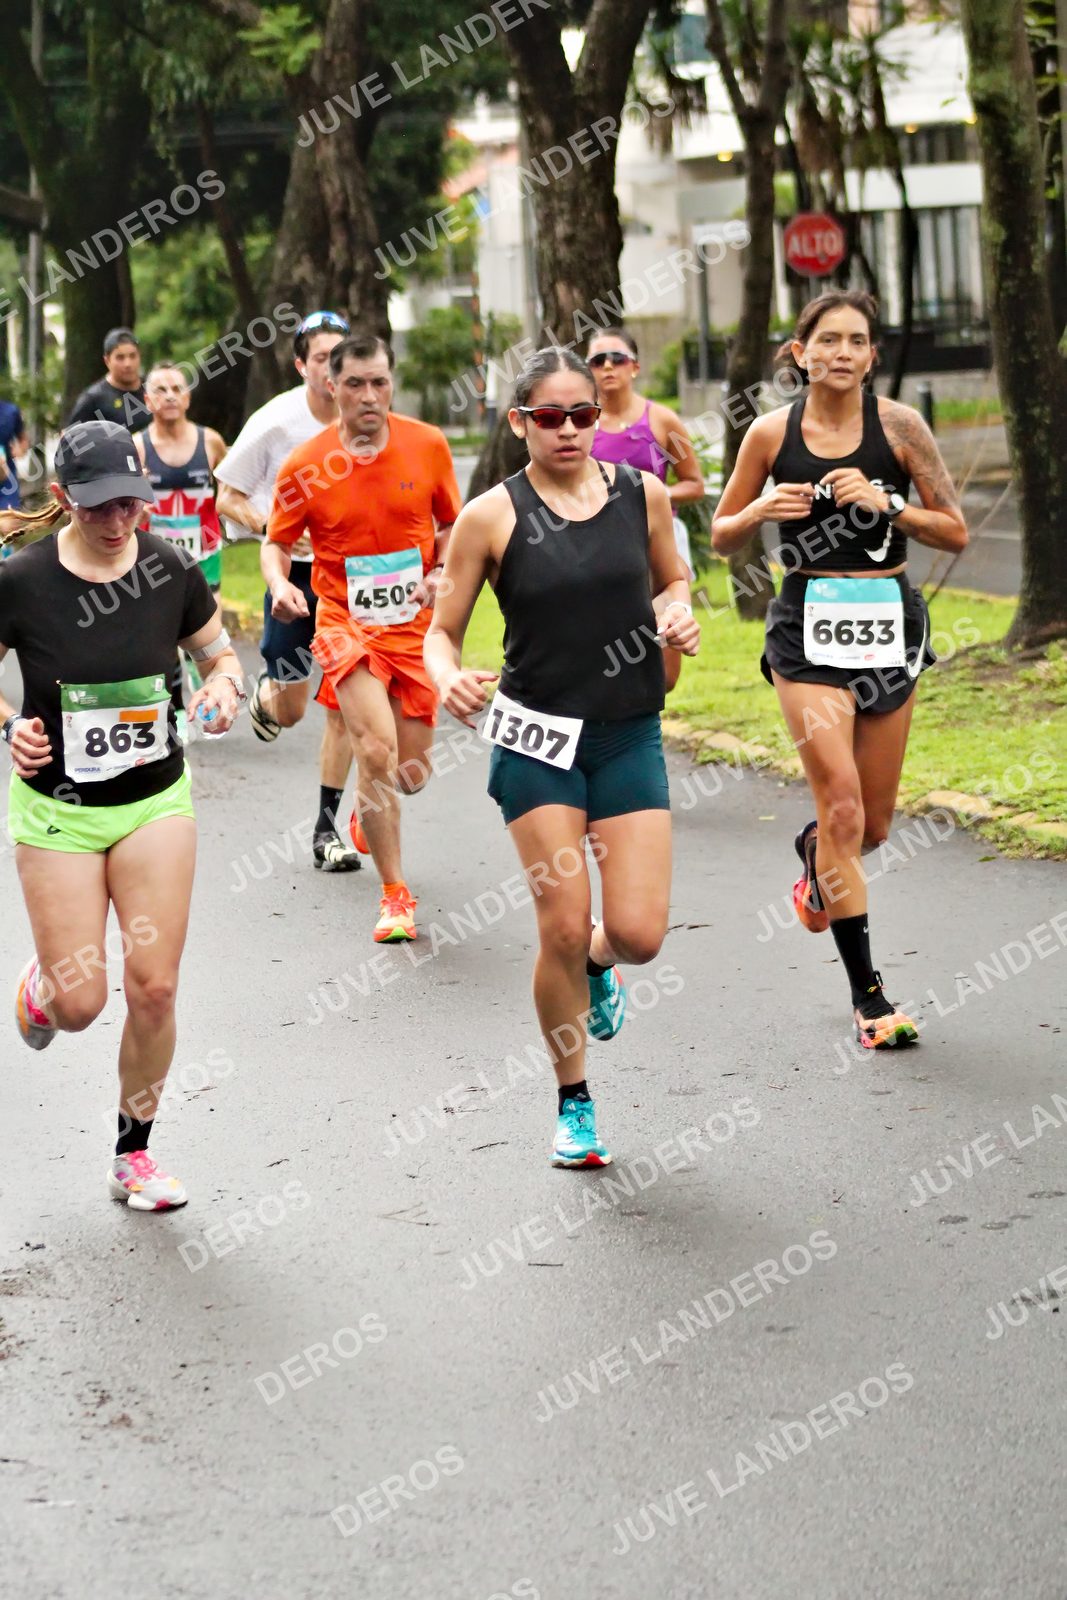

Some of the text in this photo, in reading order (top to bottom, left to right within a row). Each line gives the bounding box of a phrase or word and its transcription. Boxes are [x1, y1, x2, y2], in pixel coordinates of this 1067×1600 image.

[787, 230, 844, 258] ALTO
[812, 619, 895, 646] 6633
[85, 721, 156, 757] 863
[490, 708, 570, 760] 1307
